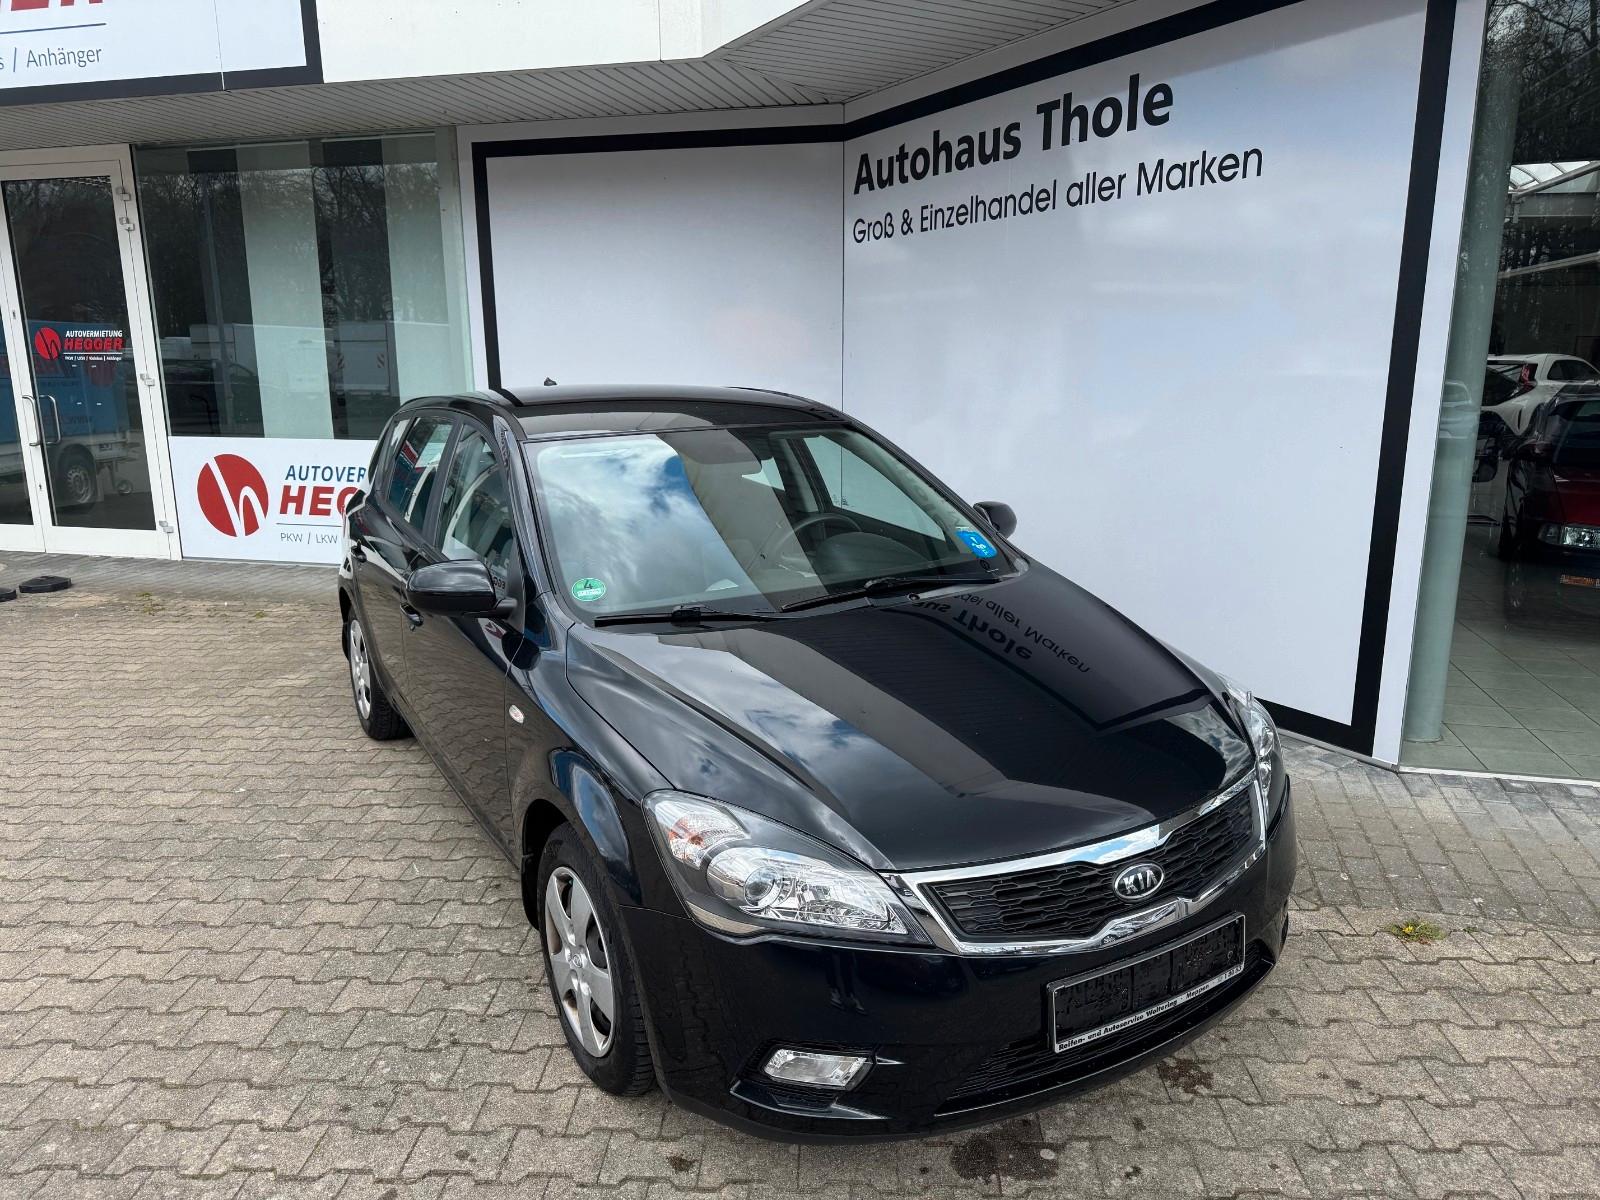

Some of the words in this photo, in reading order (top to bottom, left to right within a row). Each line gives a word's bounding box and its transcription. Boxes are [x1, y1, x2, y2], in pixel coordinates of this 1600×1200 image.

[26, 47, 102, 69] Anhänger
[853, 121, 1022, 195] Autohaus
[1036, 73, 1174, 151] Thole
[852, 212, 895, 244] Groß
[900, 209, 914, 236] &
[920, 179, 1057, 233] Einzelhandel
[1066, 173, 1127, 207] aller
[1136, 147, 1263, 196] Marken
[65, 330, 123, 338] AUTOVERMIETUNG
[64, 339, 124, 351] HEGGER
[280, 532, 304, 543] PKW
[316, 534, 338, 545] LKW
[584, 579, 593, 590] 4
[1123, 869, 1158, 894] KIA
[1185, 984, 1210, 1000] Meppen
